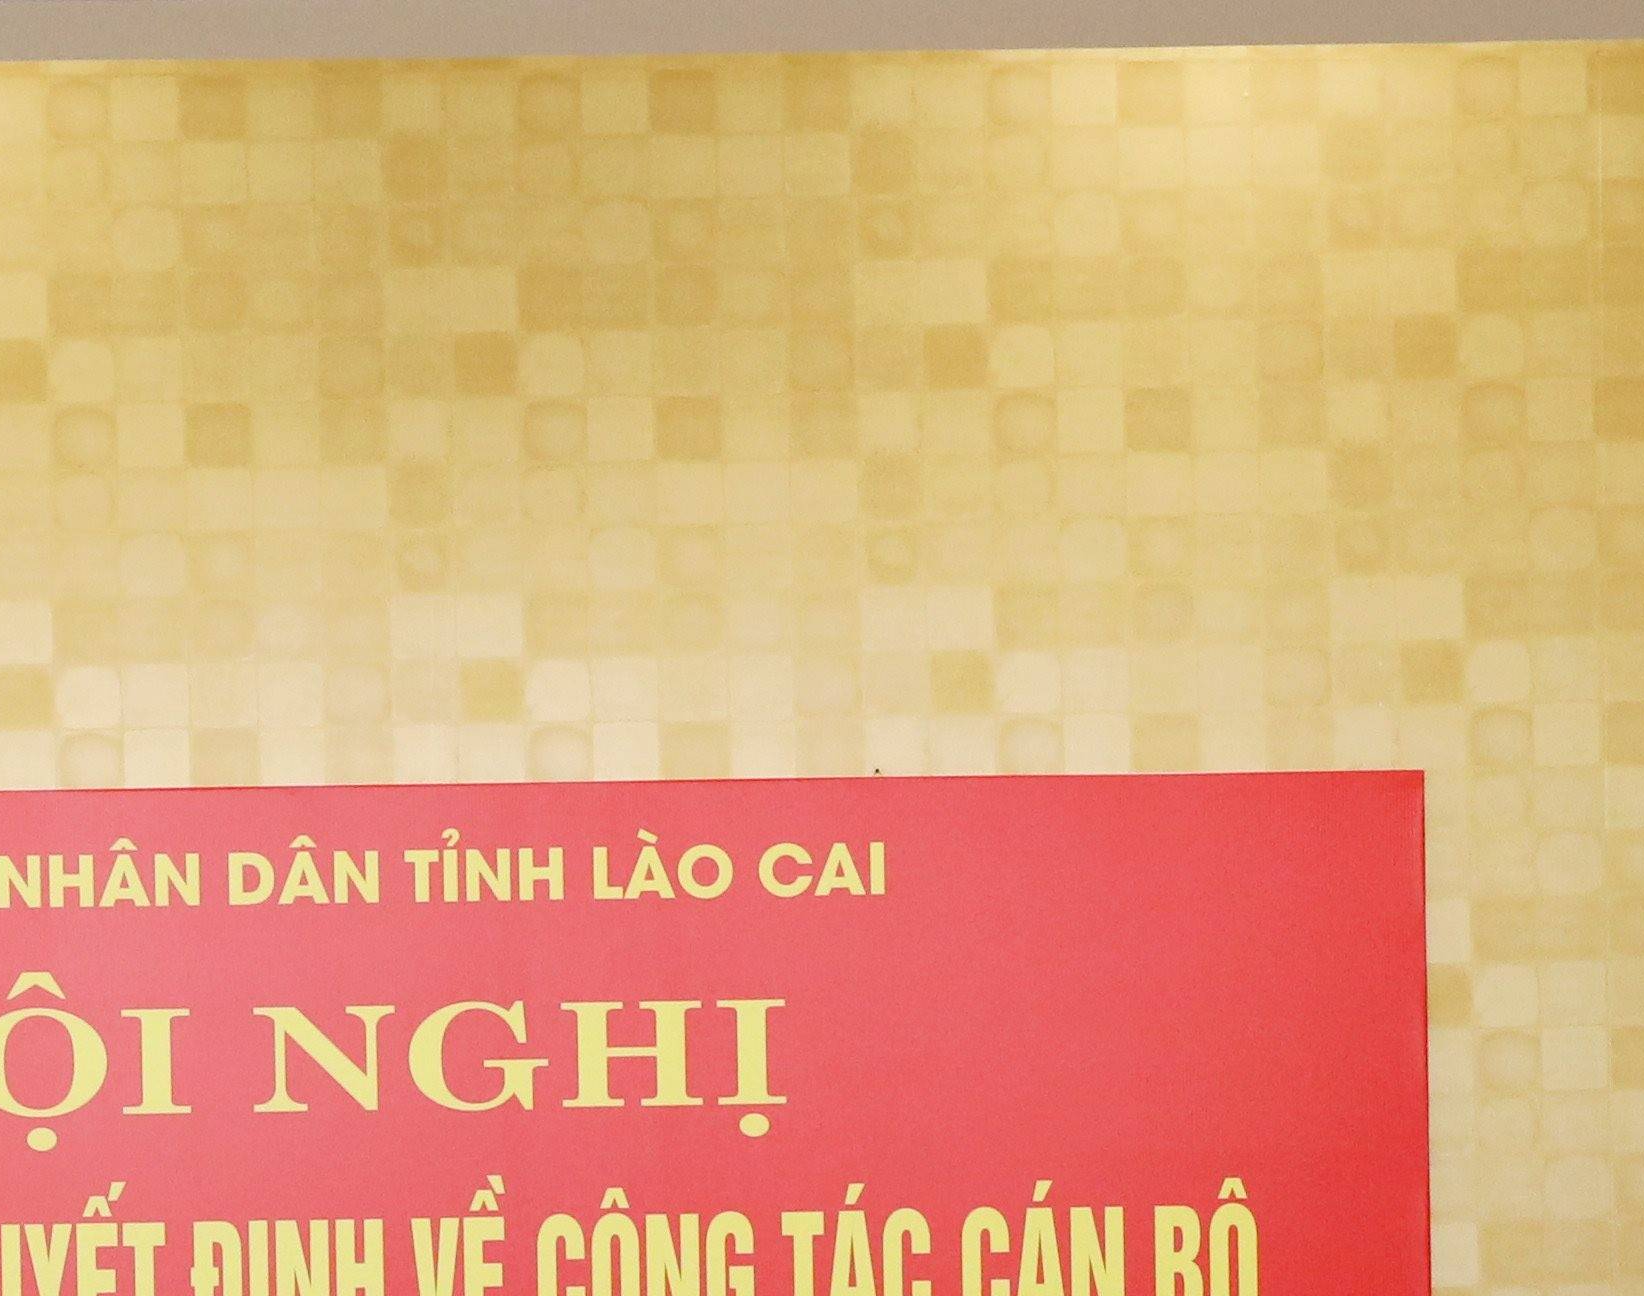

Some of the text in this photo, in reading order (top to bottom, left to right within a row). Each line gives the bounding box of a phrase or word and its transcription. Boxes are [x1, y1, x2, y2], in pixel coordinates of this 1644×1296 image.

[227, 834, 380, 906] DÂN
[403, 827, 565, 903] TỈNH
[592, 828, 734, 900] LÀO
[758, 841, 886, 898] CAI
[252, 998, 788, 1138] NGHỊ
